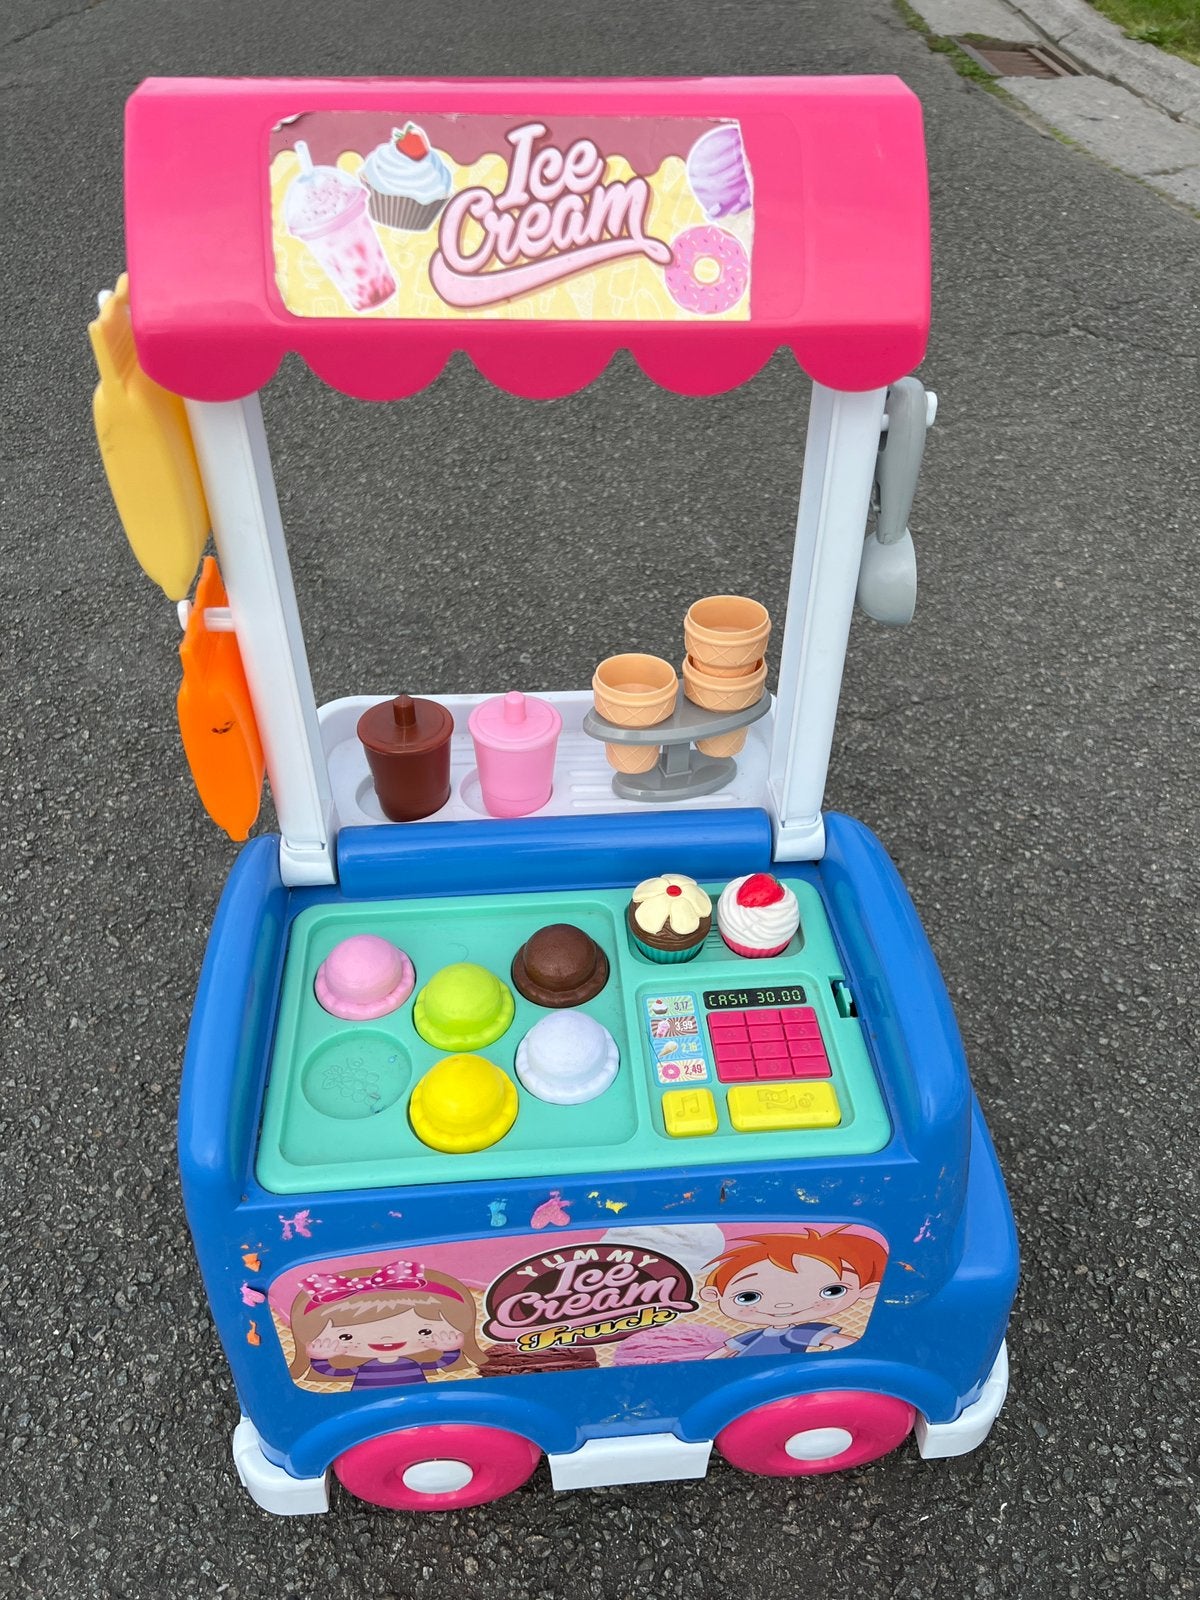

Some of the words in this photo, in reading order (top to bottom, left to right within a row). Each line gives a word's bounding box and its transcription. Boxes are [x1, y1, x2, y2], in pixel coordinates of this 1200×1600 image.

[495, 122, 604, 209] Ice
[433, 176, 671, 302] Cream
[708, 993, 749, 1006] CASH
[756, 989, 801, 1004] 30.00
[675, 1020, 693, 1032] 3,99
[684, 1064, 703, 1076] 2,49
[516, 1248, 659, 1278] YUMMY
[545, 1258, 640, 1299] Ice
[489, 1276, 693, 1338] Cream
[518, 1307, 678, 1351] Truck
